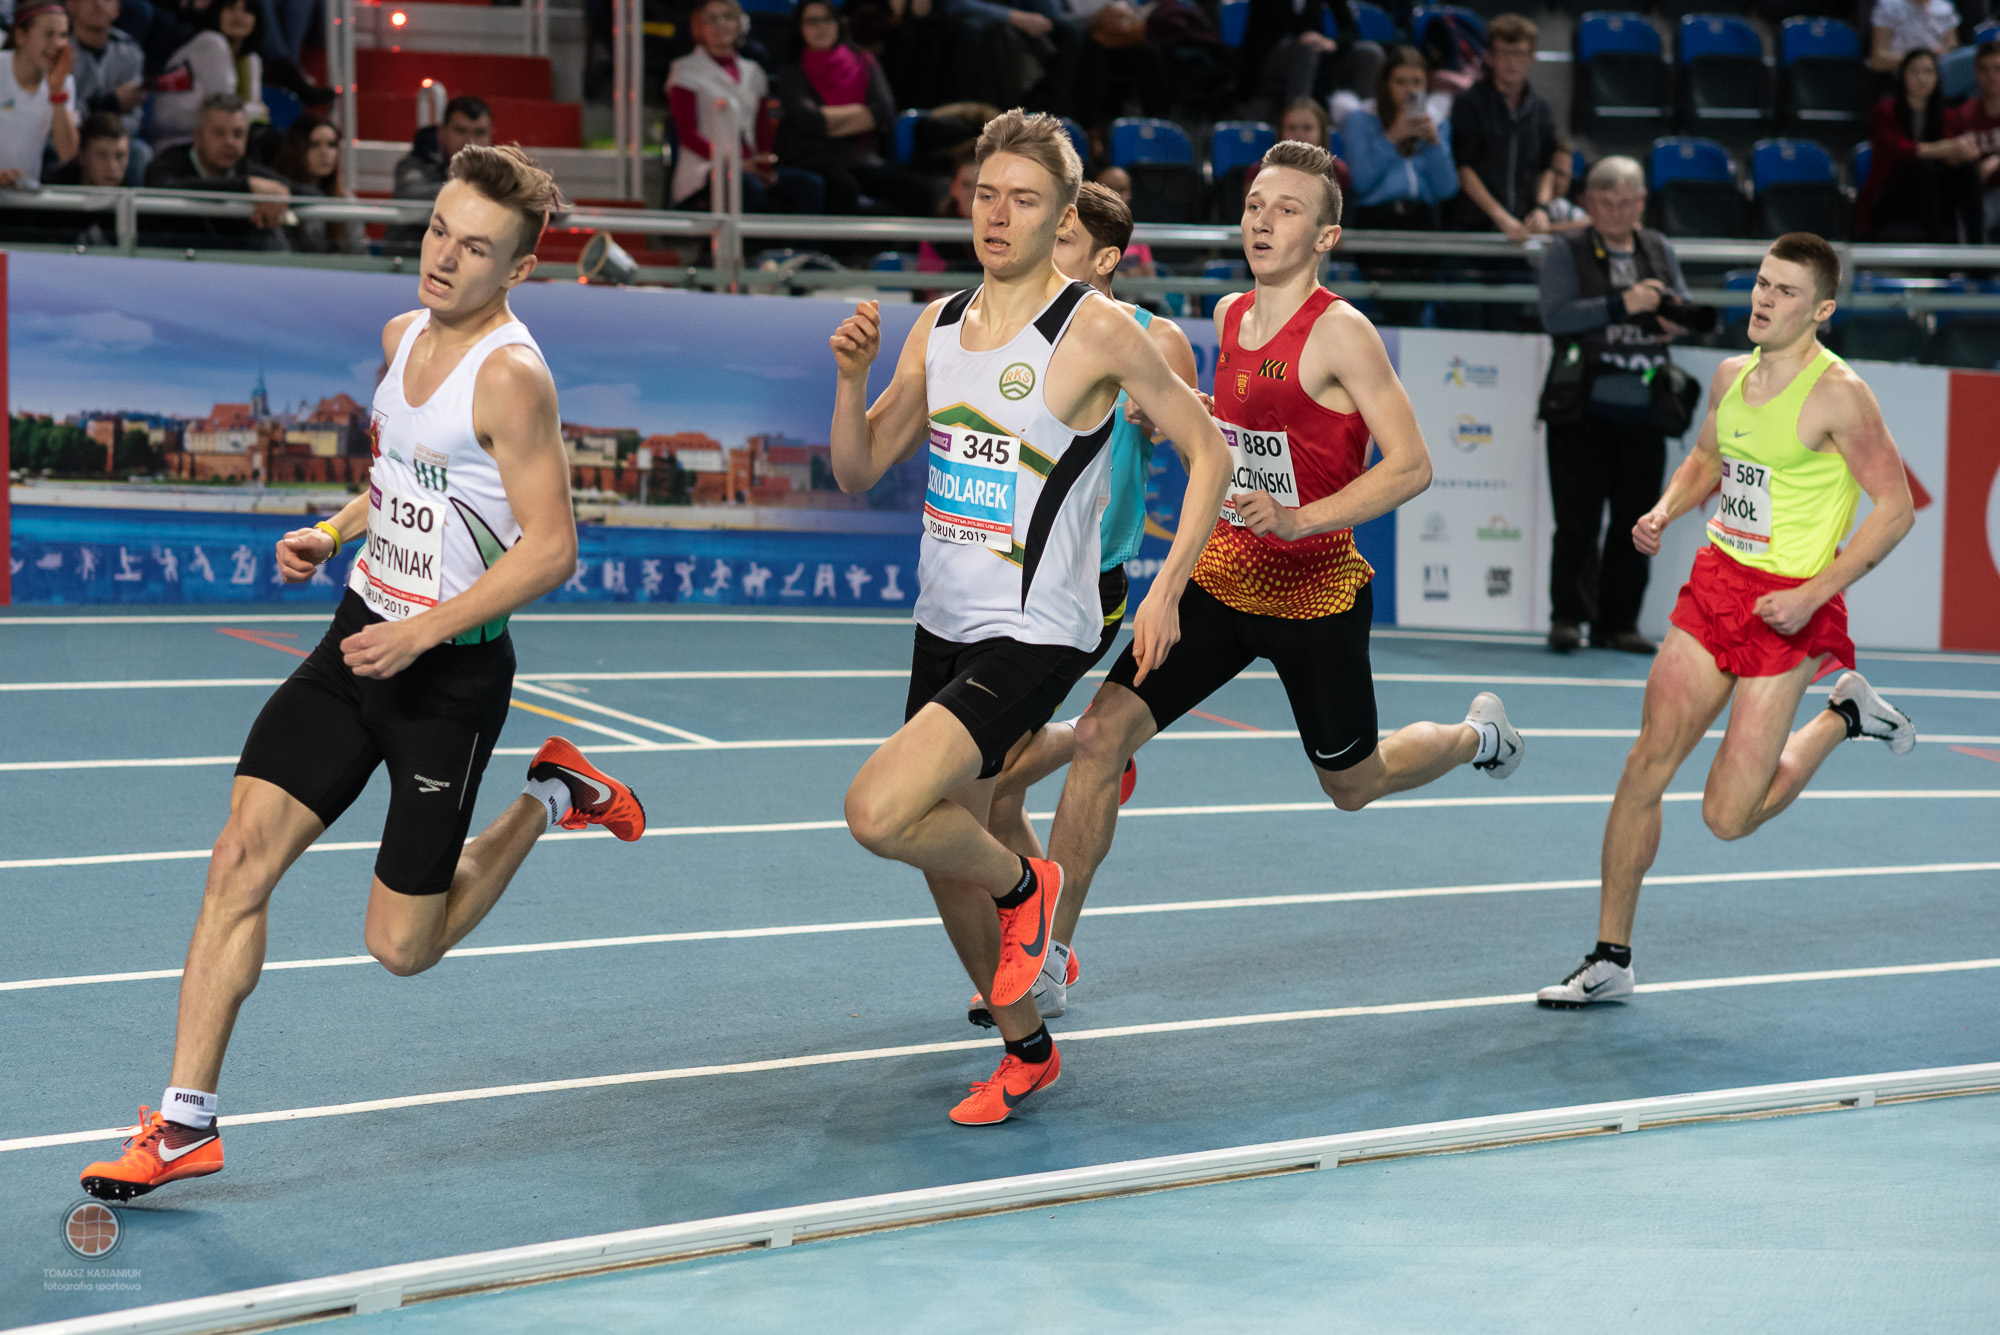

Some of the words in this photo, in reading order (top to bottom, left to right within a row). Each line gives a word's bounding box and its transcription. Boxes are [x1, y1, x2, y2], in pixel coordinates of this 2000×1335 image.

[1004, 368, 1031, 384] RKS
[962, 434, 1010, 465] 345
[1242, 432, 1282, 457] 880
[1230, 466, 1293, 494] ACZYŃSKI
[1736, 463, 1765, 488] 587
[390, 496, 434, 533] 130
[1222, 509, 1245, 524] TORU
[1720, 494, 1758, 522] OKÓŁ
[929, 520, 956, 539] TORUŃ
[959, 529, 987, 543] 2019
[367, 524, 434, 581] USTYNIAK
[1736, 539, 1753, 552] 2019
[384, 598, 410, 617] 2019
[413, 773, 451, 788] BROOKS
[174, 1092, 205, 1107] PUMA
